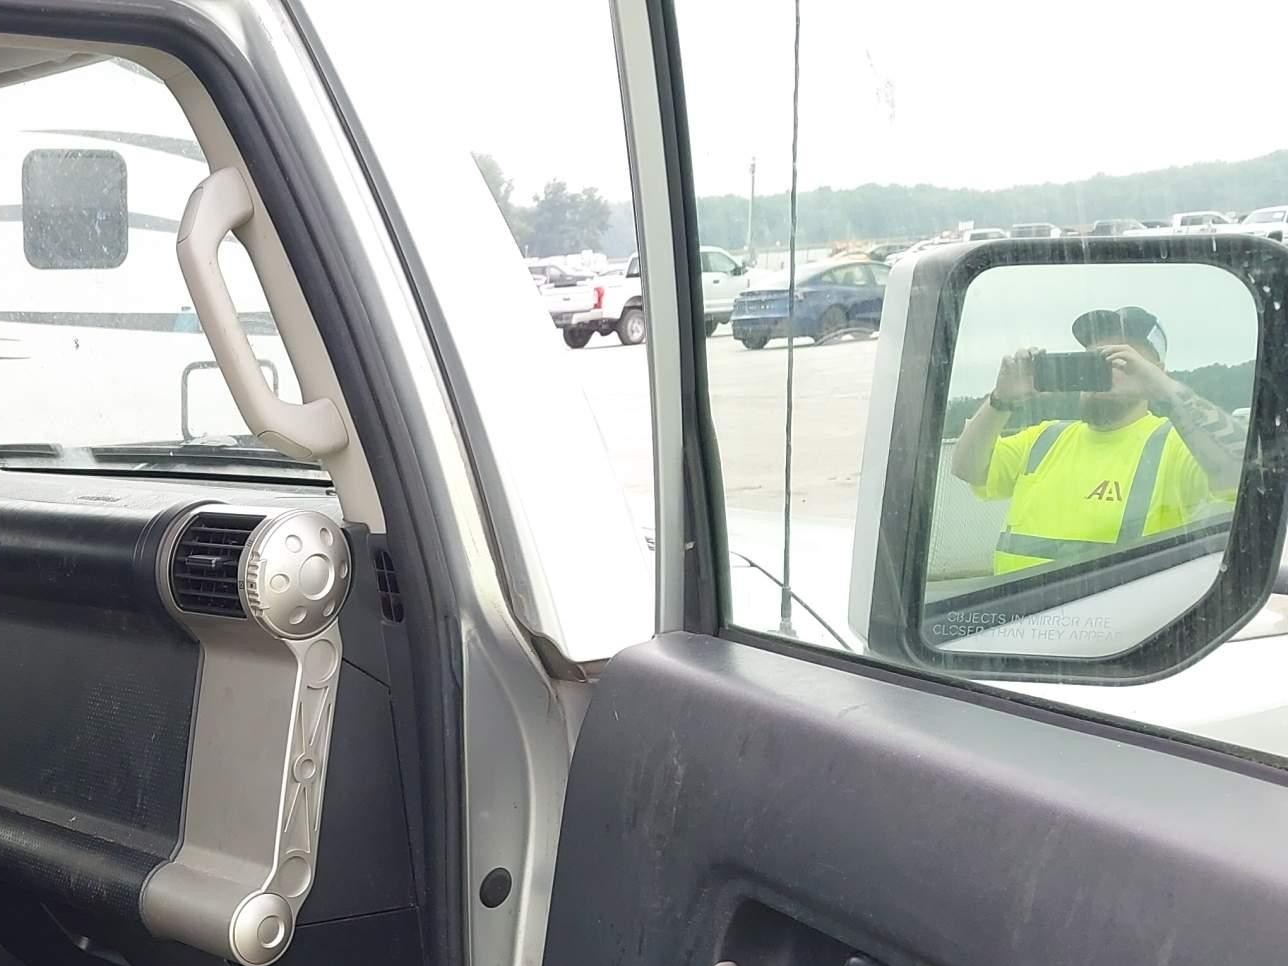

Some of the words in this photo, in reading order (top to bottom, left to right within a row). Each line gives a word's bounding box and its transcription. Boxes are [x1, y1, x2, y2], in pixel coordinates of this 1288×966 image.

[947, 611, 1006, 624] OBJECTS
[1011, 615, 1026, 626] IN
[1028, 615, 1081, 628] MIRROR
[1084, 616, 1113, 629] ARE
[991, 628, 1025, 640] THAN
[1031, 628, 1065, 641] THEY
